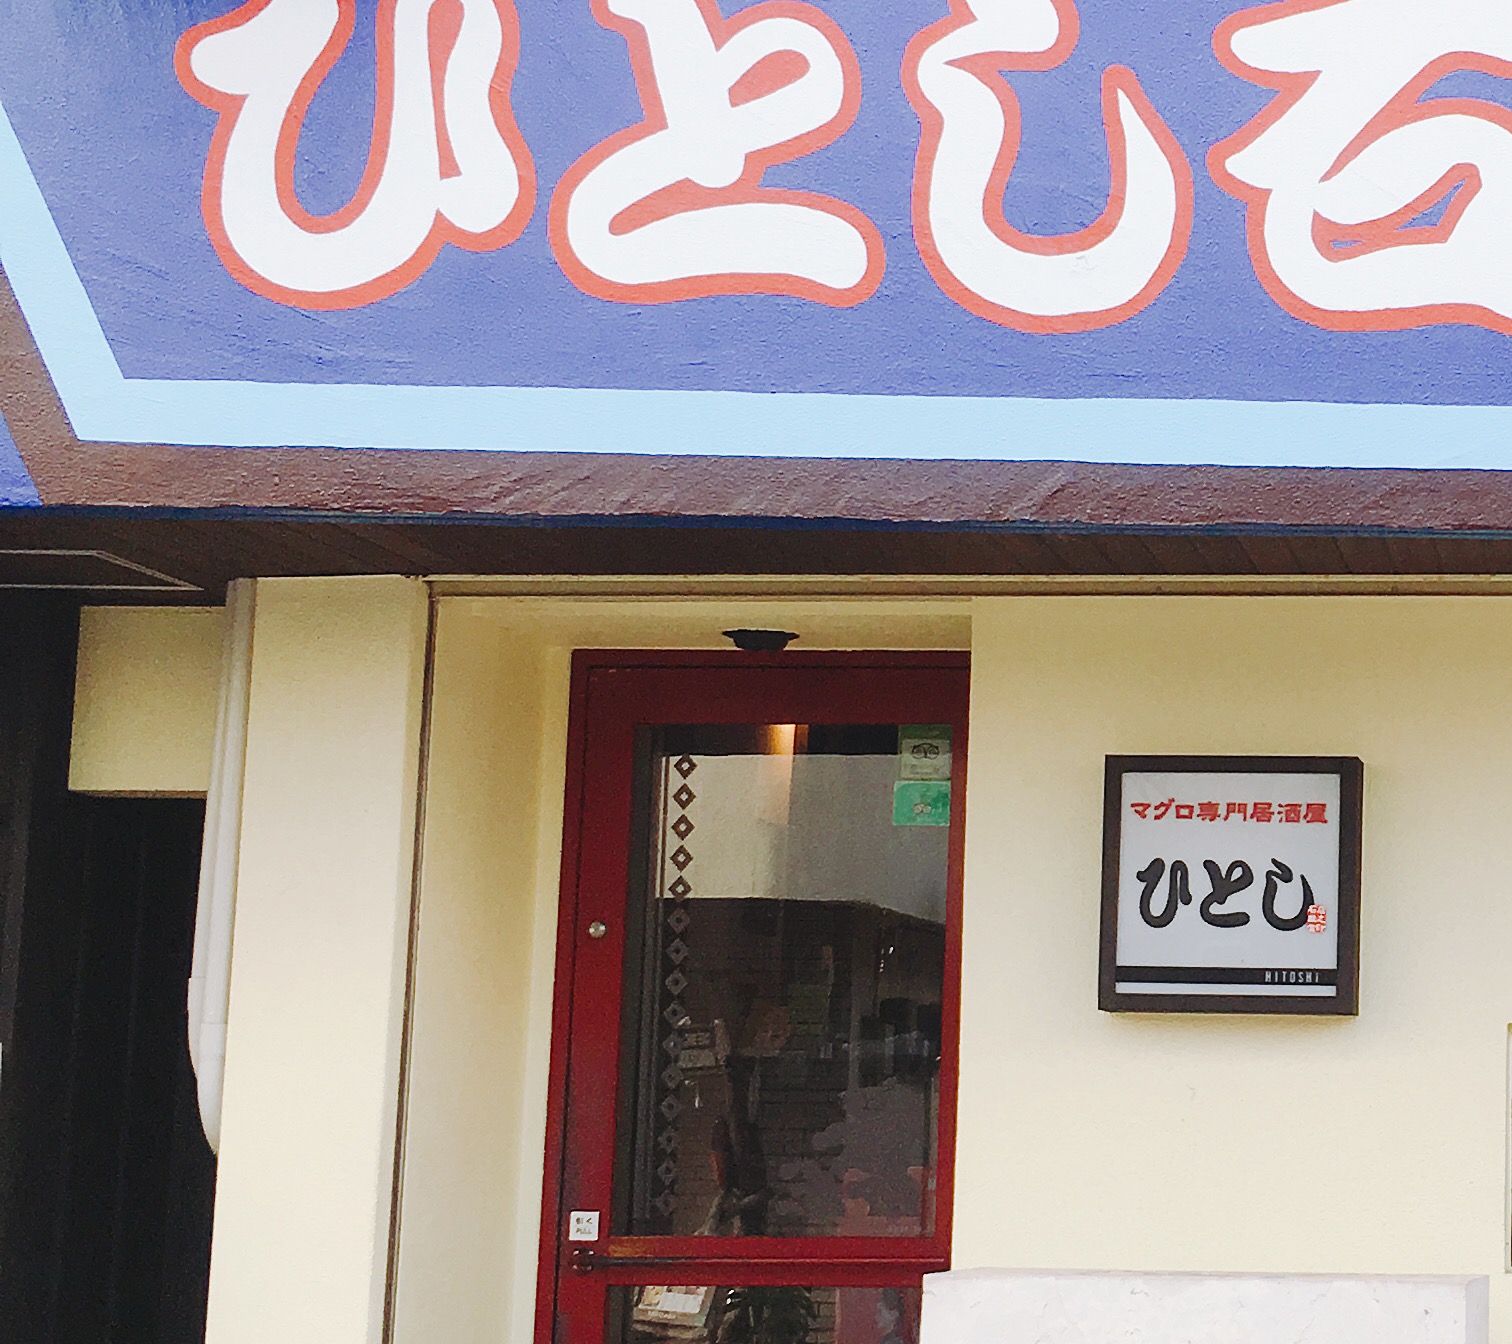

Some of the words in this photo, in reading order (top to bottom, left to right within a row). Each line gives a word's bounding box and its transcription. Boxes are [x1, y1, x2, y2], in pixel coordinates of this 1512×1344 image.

[1130, 797, 1329, 824] マグロ専門居酒屋
[1136, 857, 1316, 932] ひとし
[1264, 970, 1320, 984] HITOSHI
